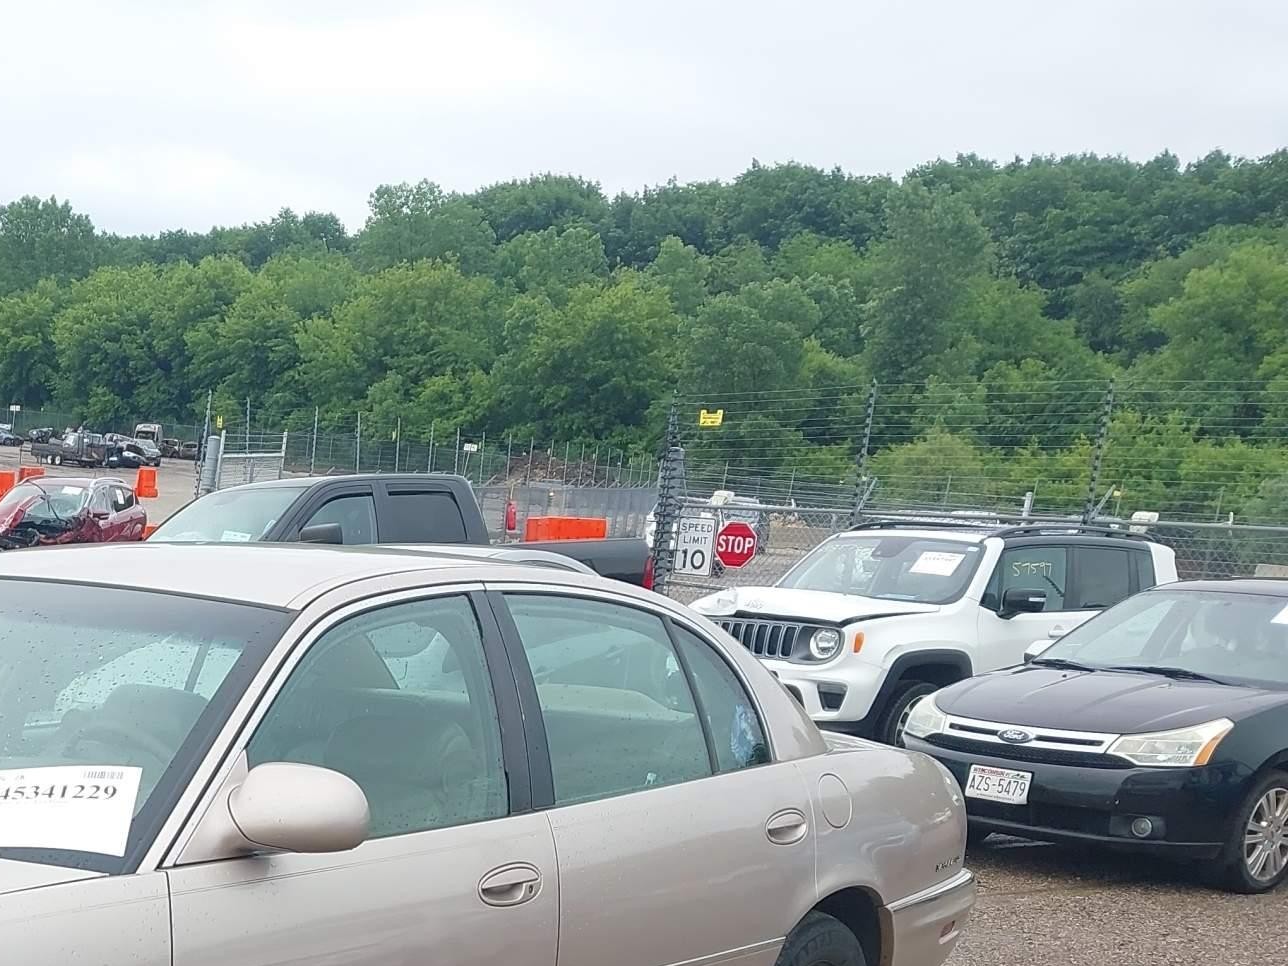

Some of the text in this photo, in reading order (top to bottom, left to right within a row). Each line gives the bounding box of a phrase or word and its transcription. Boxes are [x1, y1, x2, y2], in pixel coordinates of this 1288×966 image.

[681, 523, 713, 533] SPEED
[683, 535, 709, 545] LIMIT
[717, 534, 755, 555] STOP
[681, 548, 706, 570] 10
[968, 774, 1027, 797] AZS-5479
